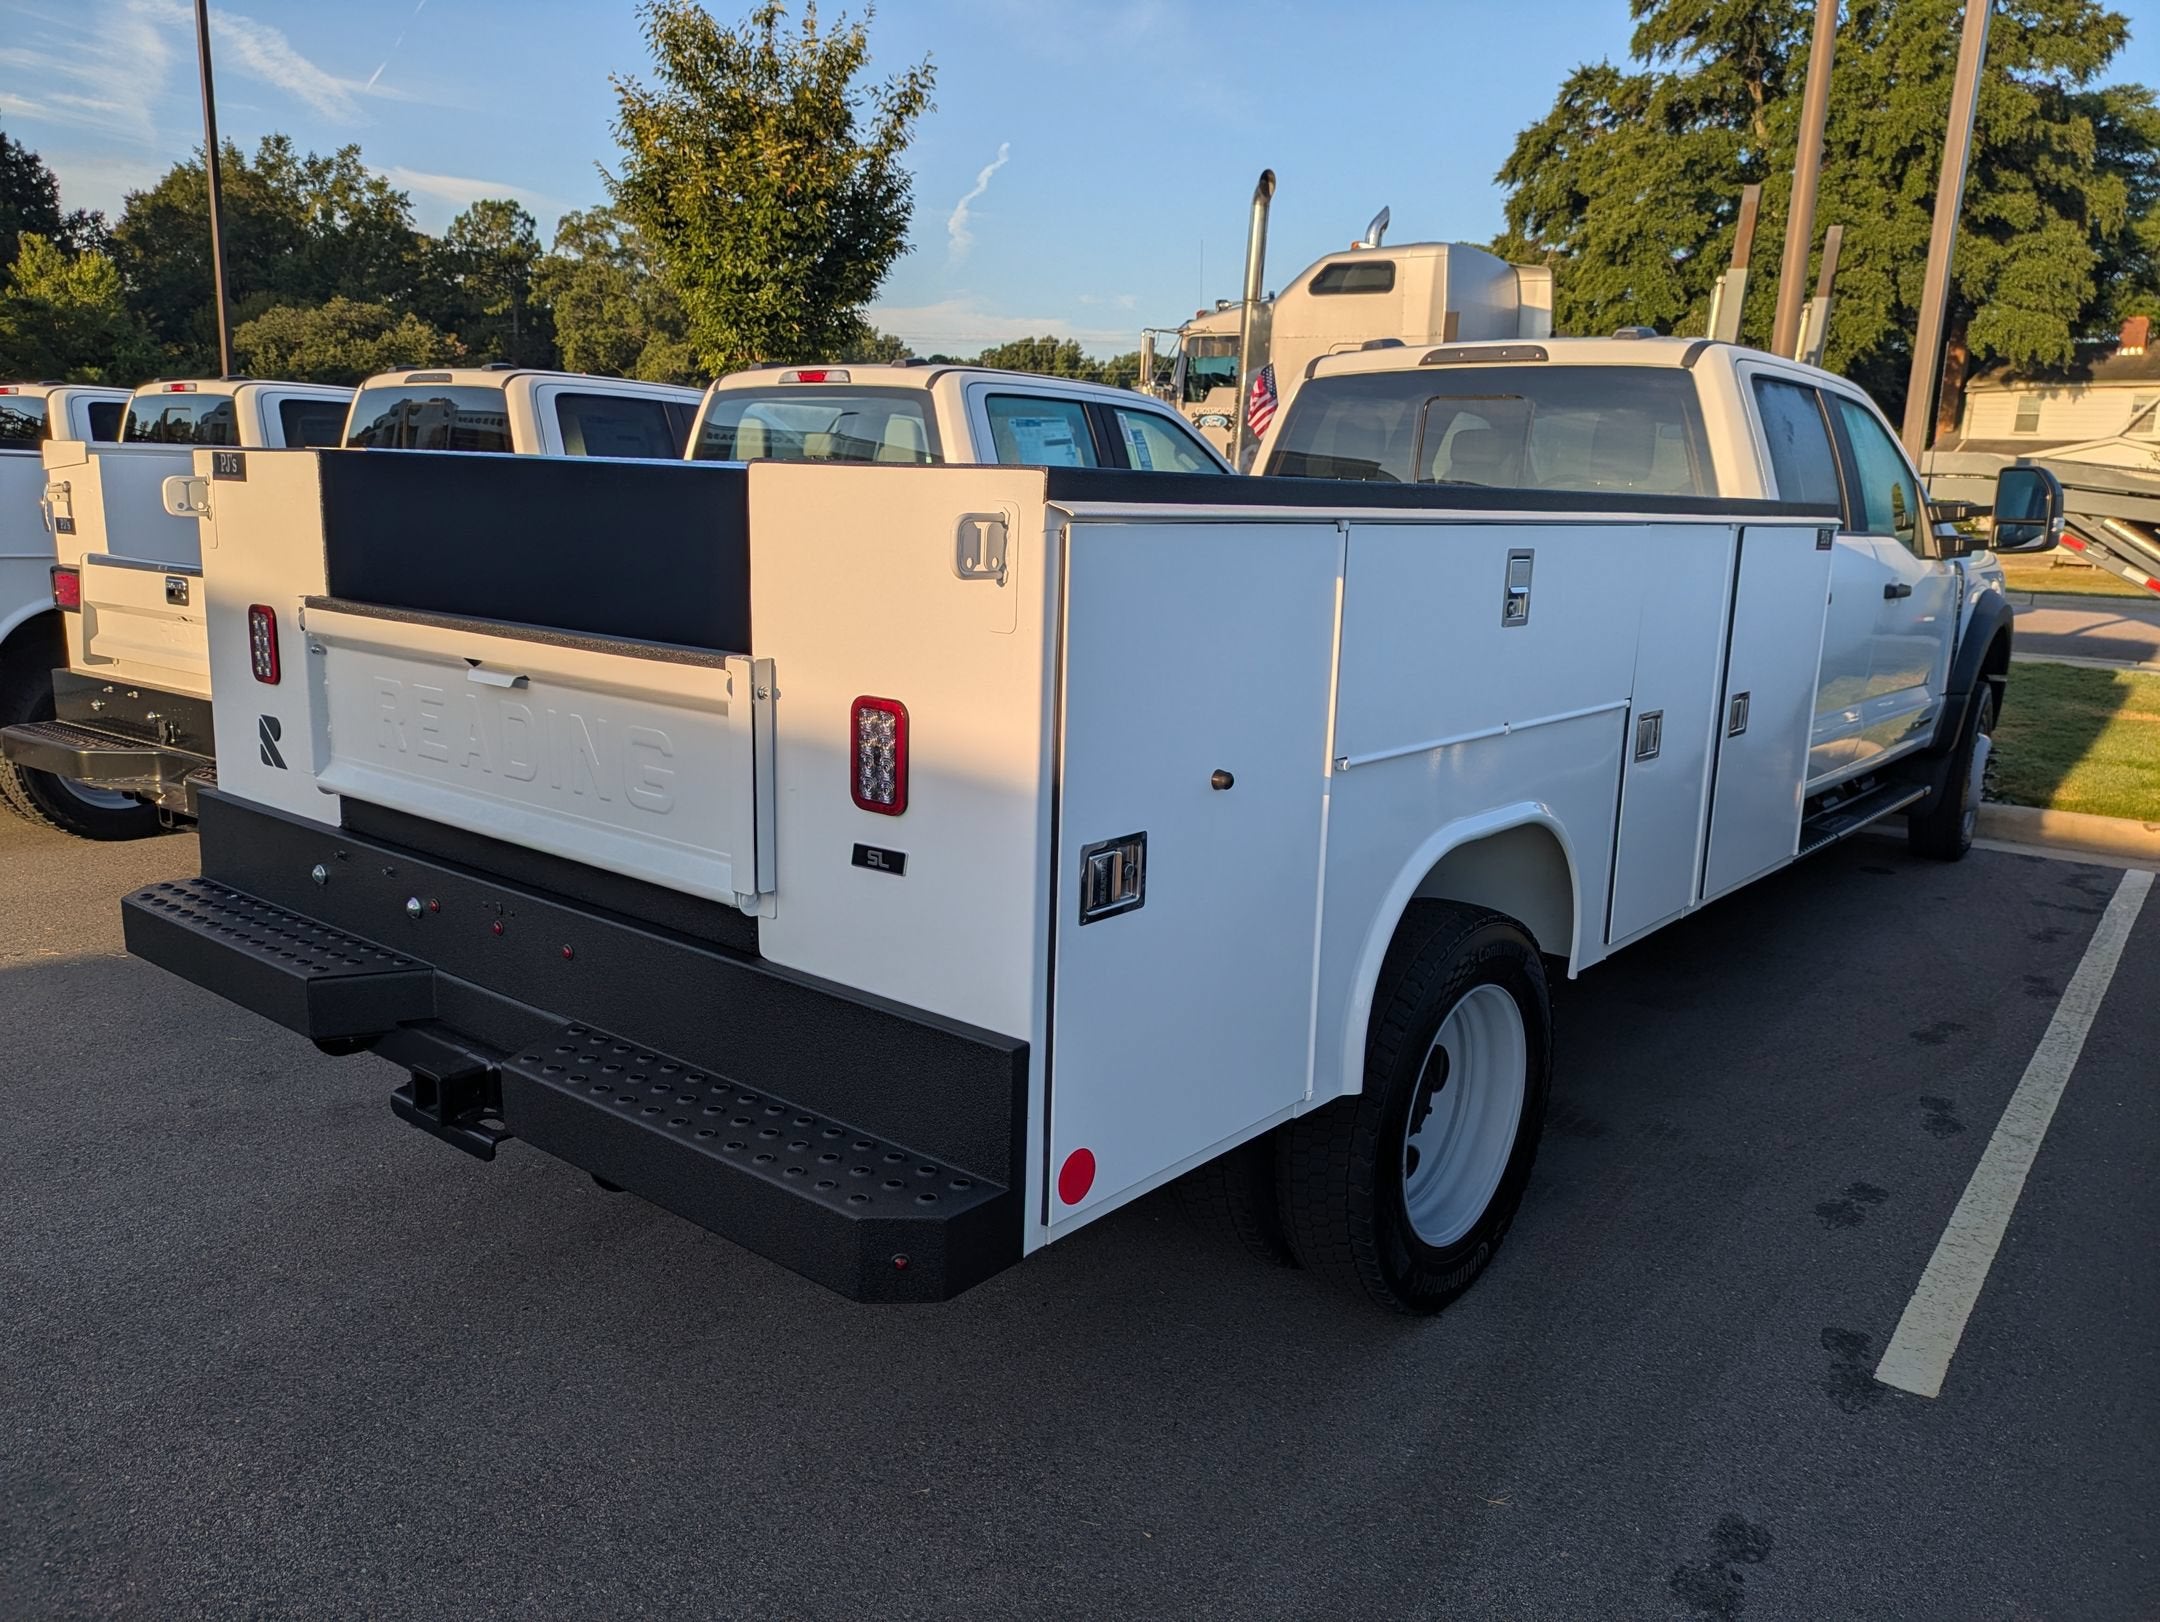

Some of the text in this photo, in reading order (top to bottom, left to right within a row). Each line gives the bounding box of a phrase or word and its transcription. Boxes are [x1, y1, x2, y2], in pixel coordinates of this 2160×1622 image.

[220, 453, 237, 473] PJ's
[373, 675, 677, 816] READING
[867, 850, 889, 869] SL
